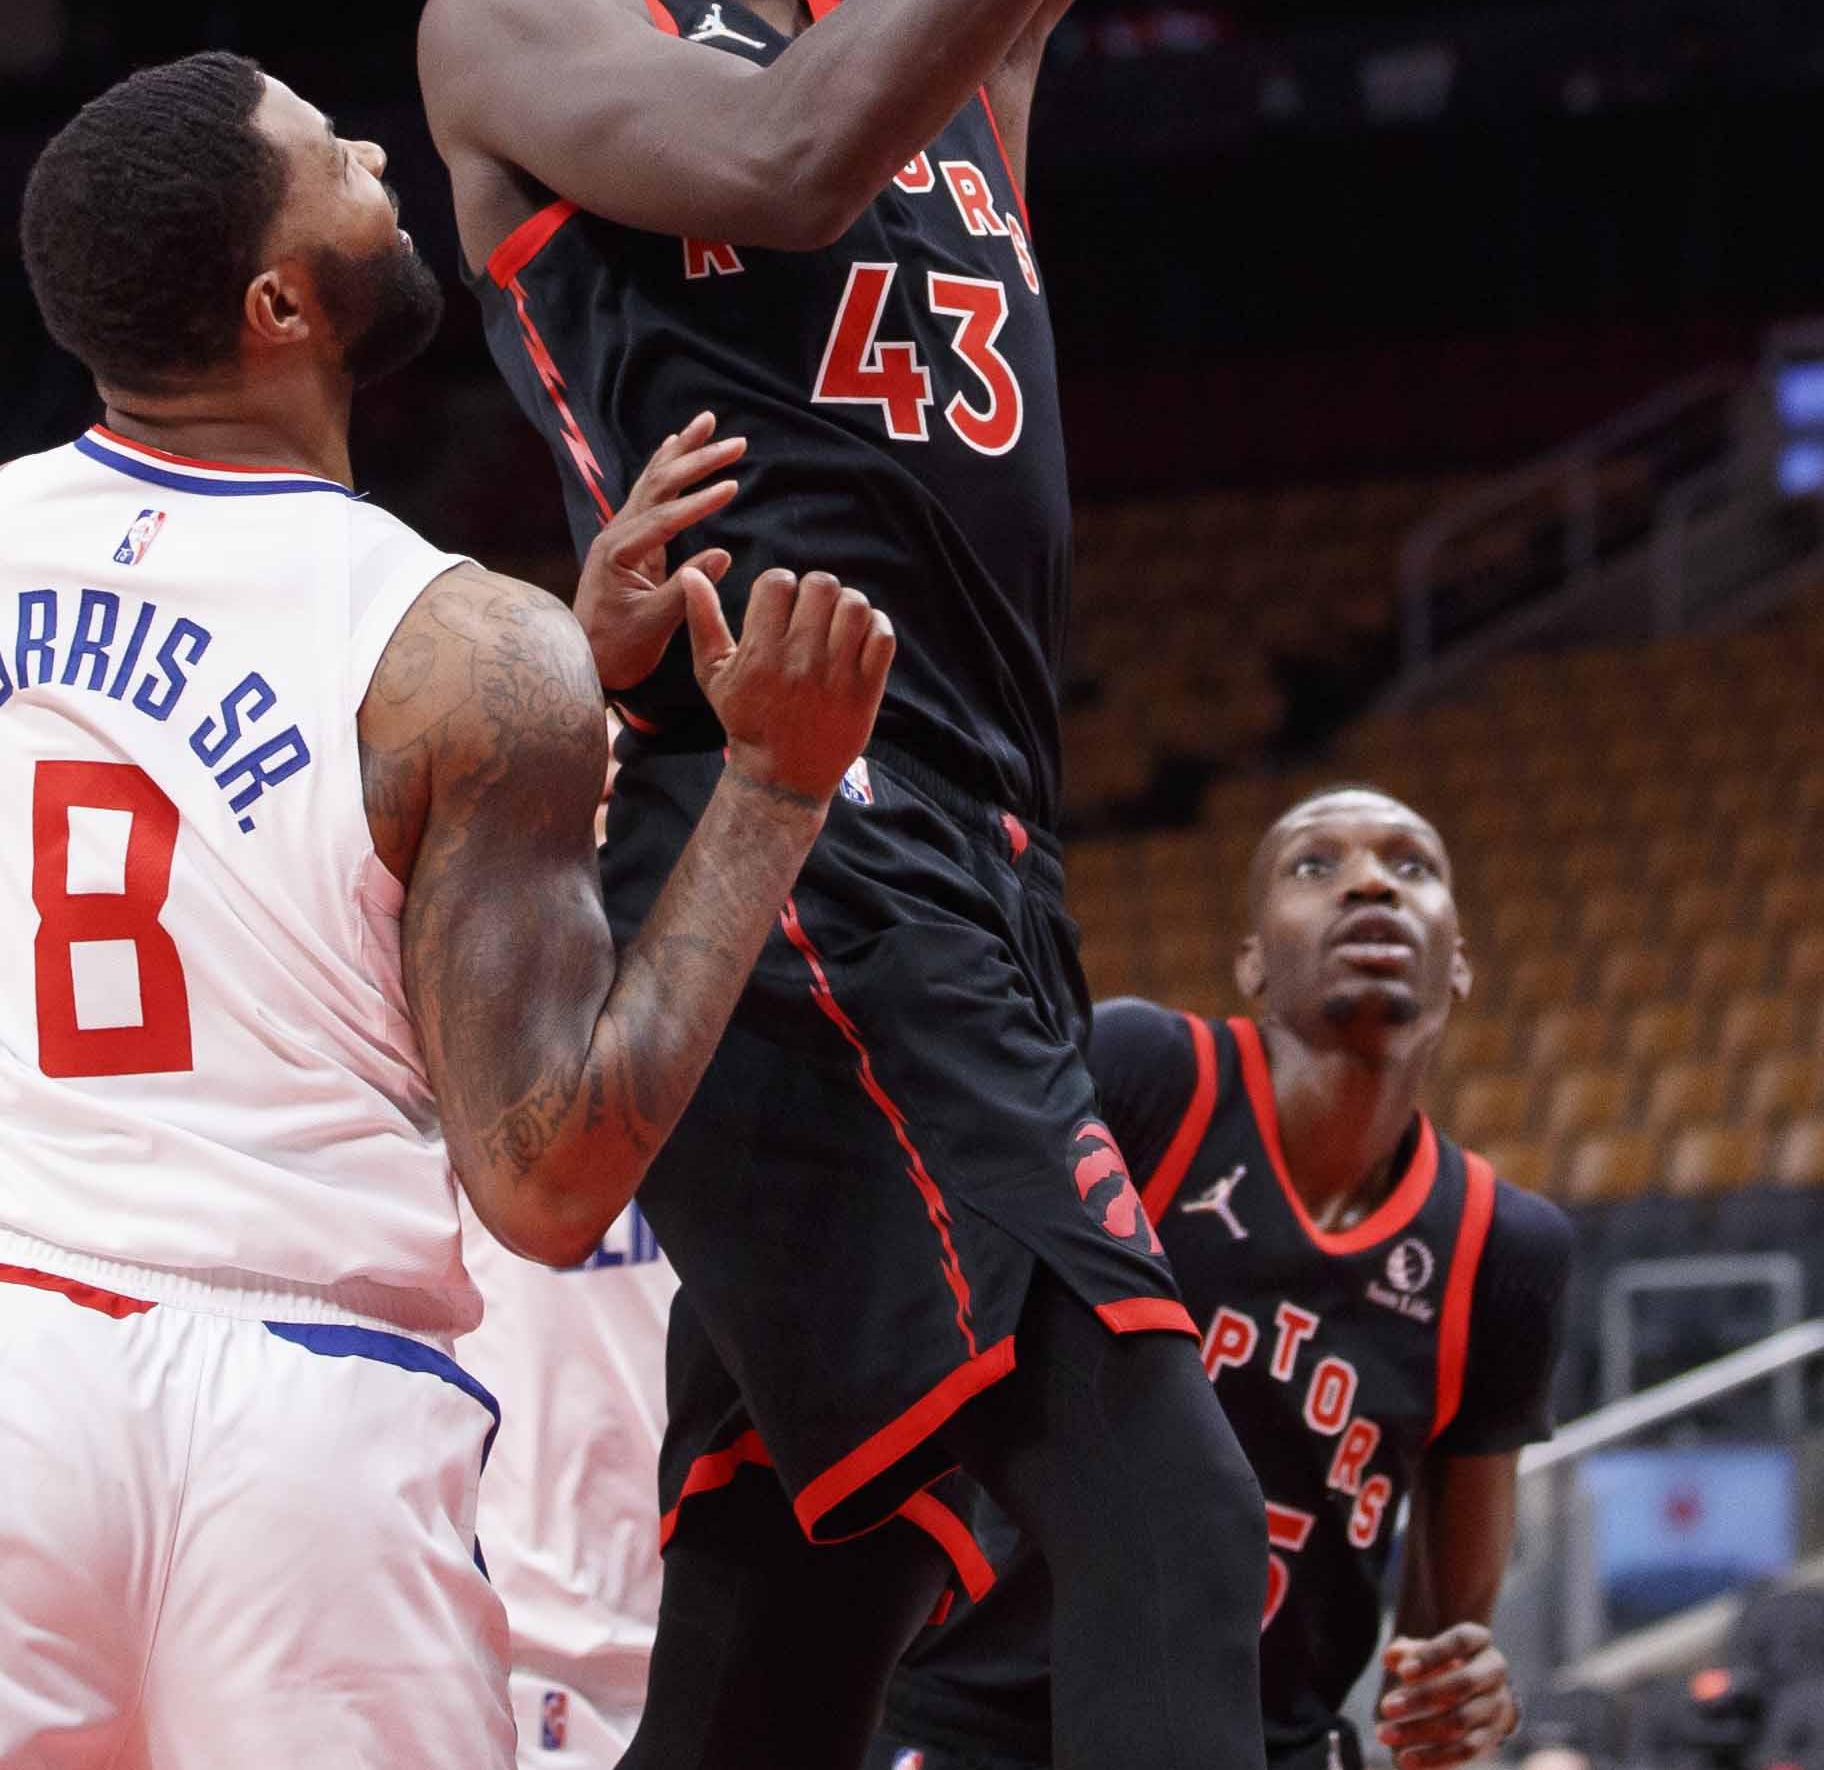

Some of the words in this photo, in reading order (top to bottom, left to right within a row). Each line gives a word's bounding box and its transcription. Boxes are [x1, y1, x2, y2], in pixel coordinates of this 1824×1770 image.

[811, 262, 1023, 456] 43
[189, 671, 311, 834] SR.
[32, 759, 194, 1078] 8
